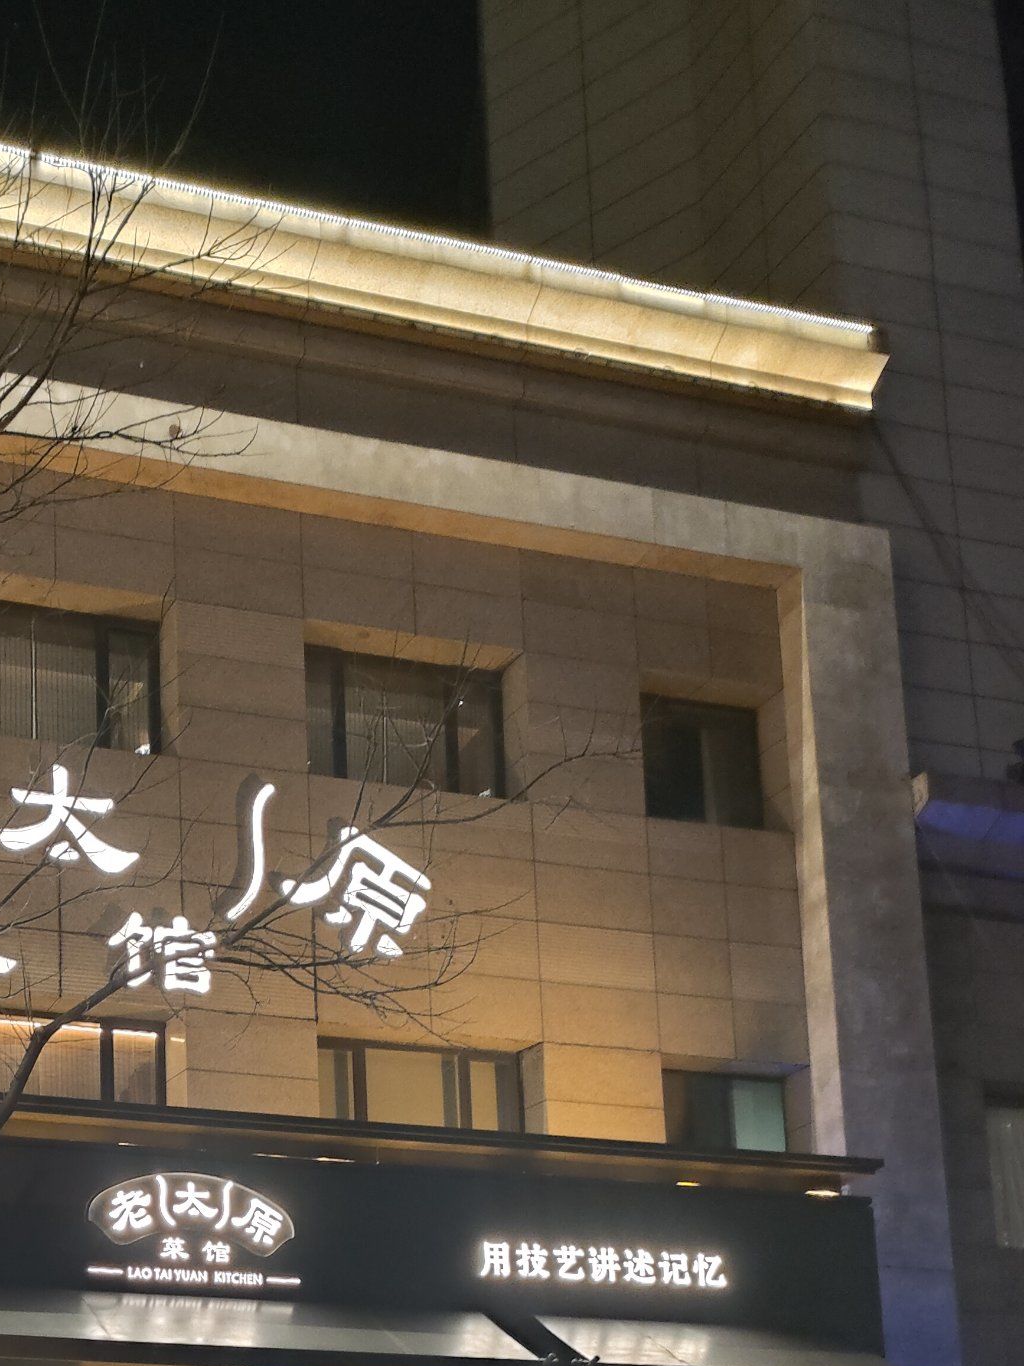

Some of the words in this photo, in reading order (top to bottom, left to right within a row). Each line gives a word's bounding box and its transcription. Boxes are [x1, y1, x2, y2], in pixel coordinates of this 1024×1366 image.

[109, 1175, 283, 1245] 老太原
[160, 1237, 231, 1263] 菜馆
[480, 1241, 728, 1289] 用技艺讲述记忆
[127, 1265, 152, 1280] LAO
[154, 1267, 172, 1281] TAI
[174, 1268, 208, 1283] YUAN
[214, 1271, 263, 1286] KITCHEN
